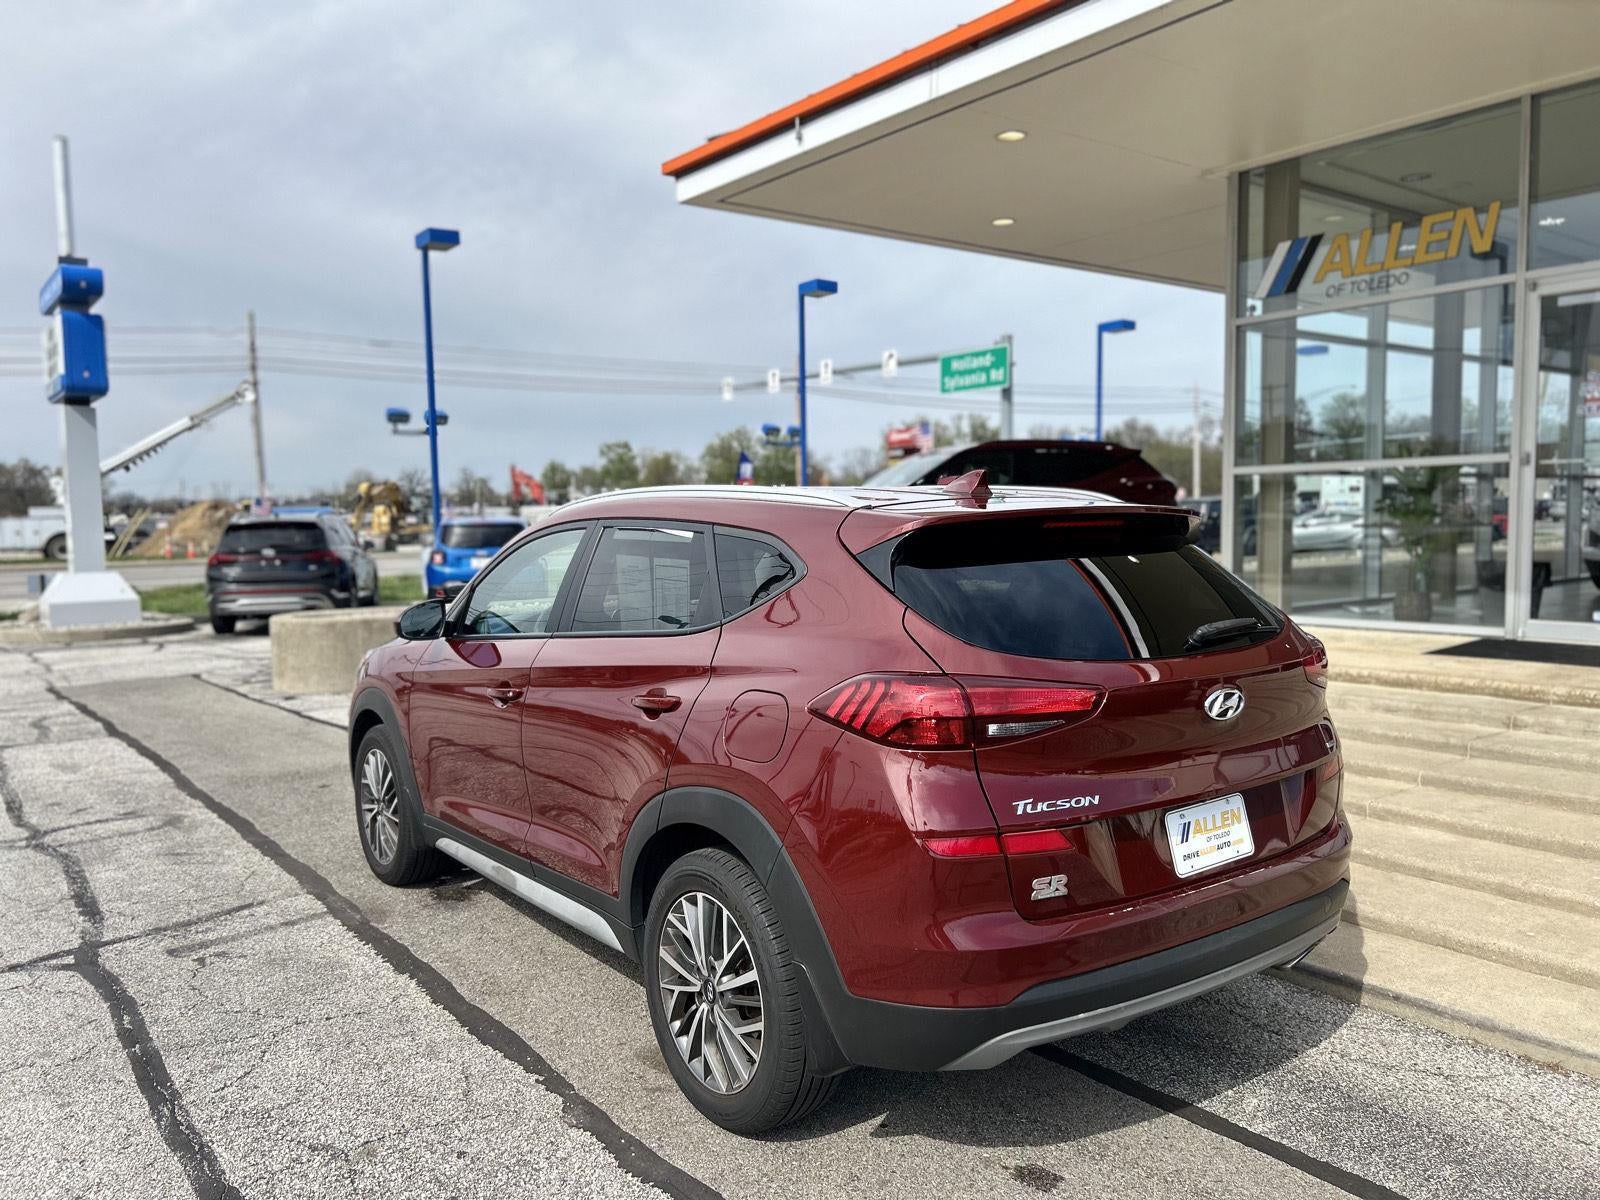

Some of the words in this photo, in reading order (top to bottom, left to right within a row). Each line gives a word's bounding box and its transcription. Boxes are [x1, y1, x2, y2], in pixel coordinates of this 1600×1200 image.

[1313, 200, 1500, 284] ALLEN
[1325, 281, 1349, 298] OF
[1349, 271, 1410, 293] TOLEDO
[1192, 807, 1243, 838] ALLEN
[1206, 835, 1213, 843] OF
[1213, 830, 1231, 841] TOLEDO
